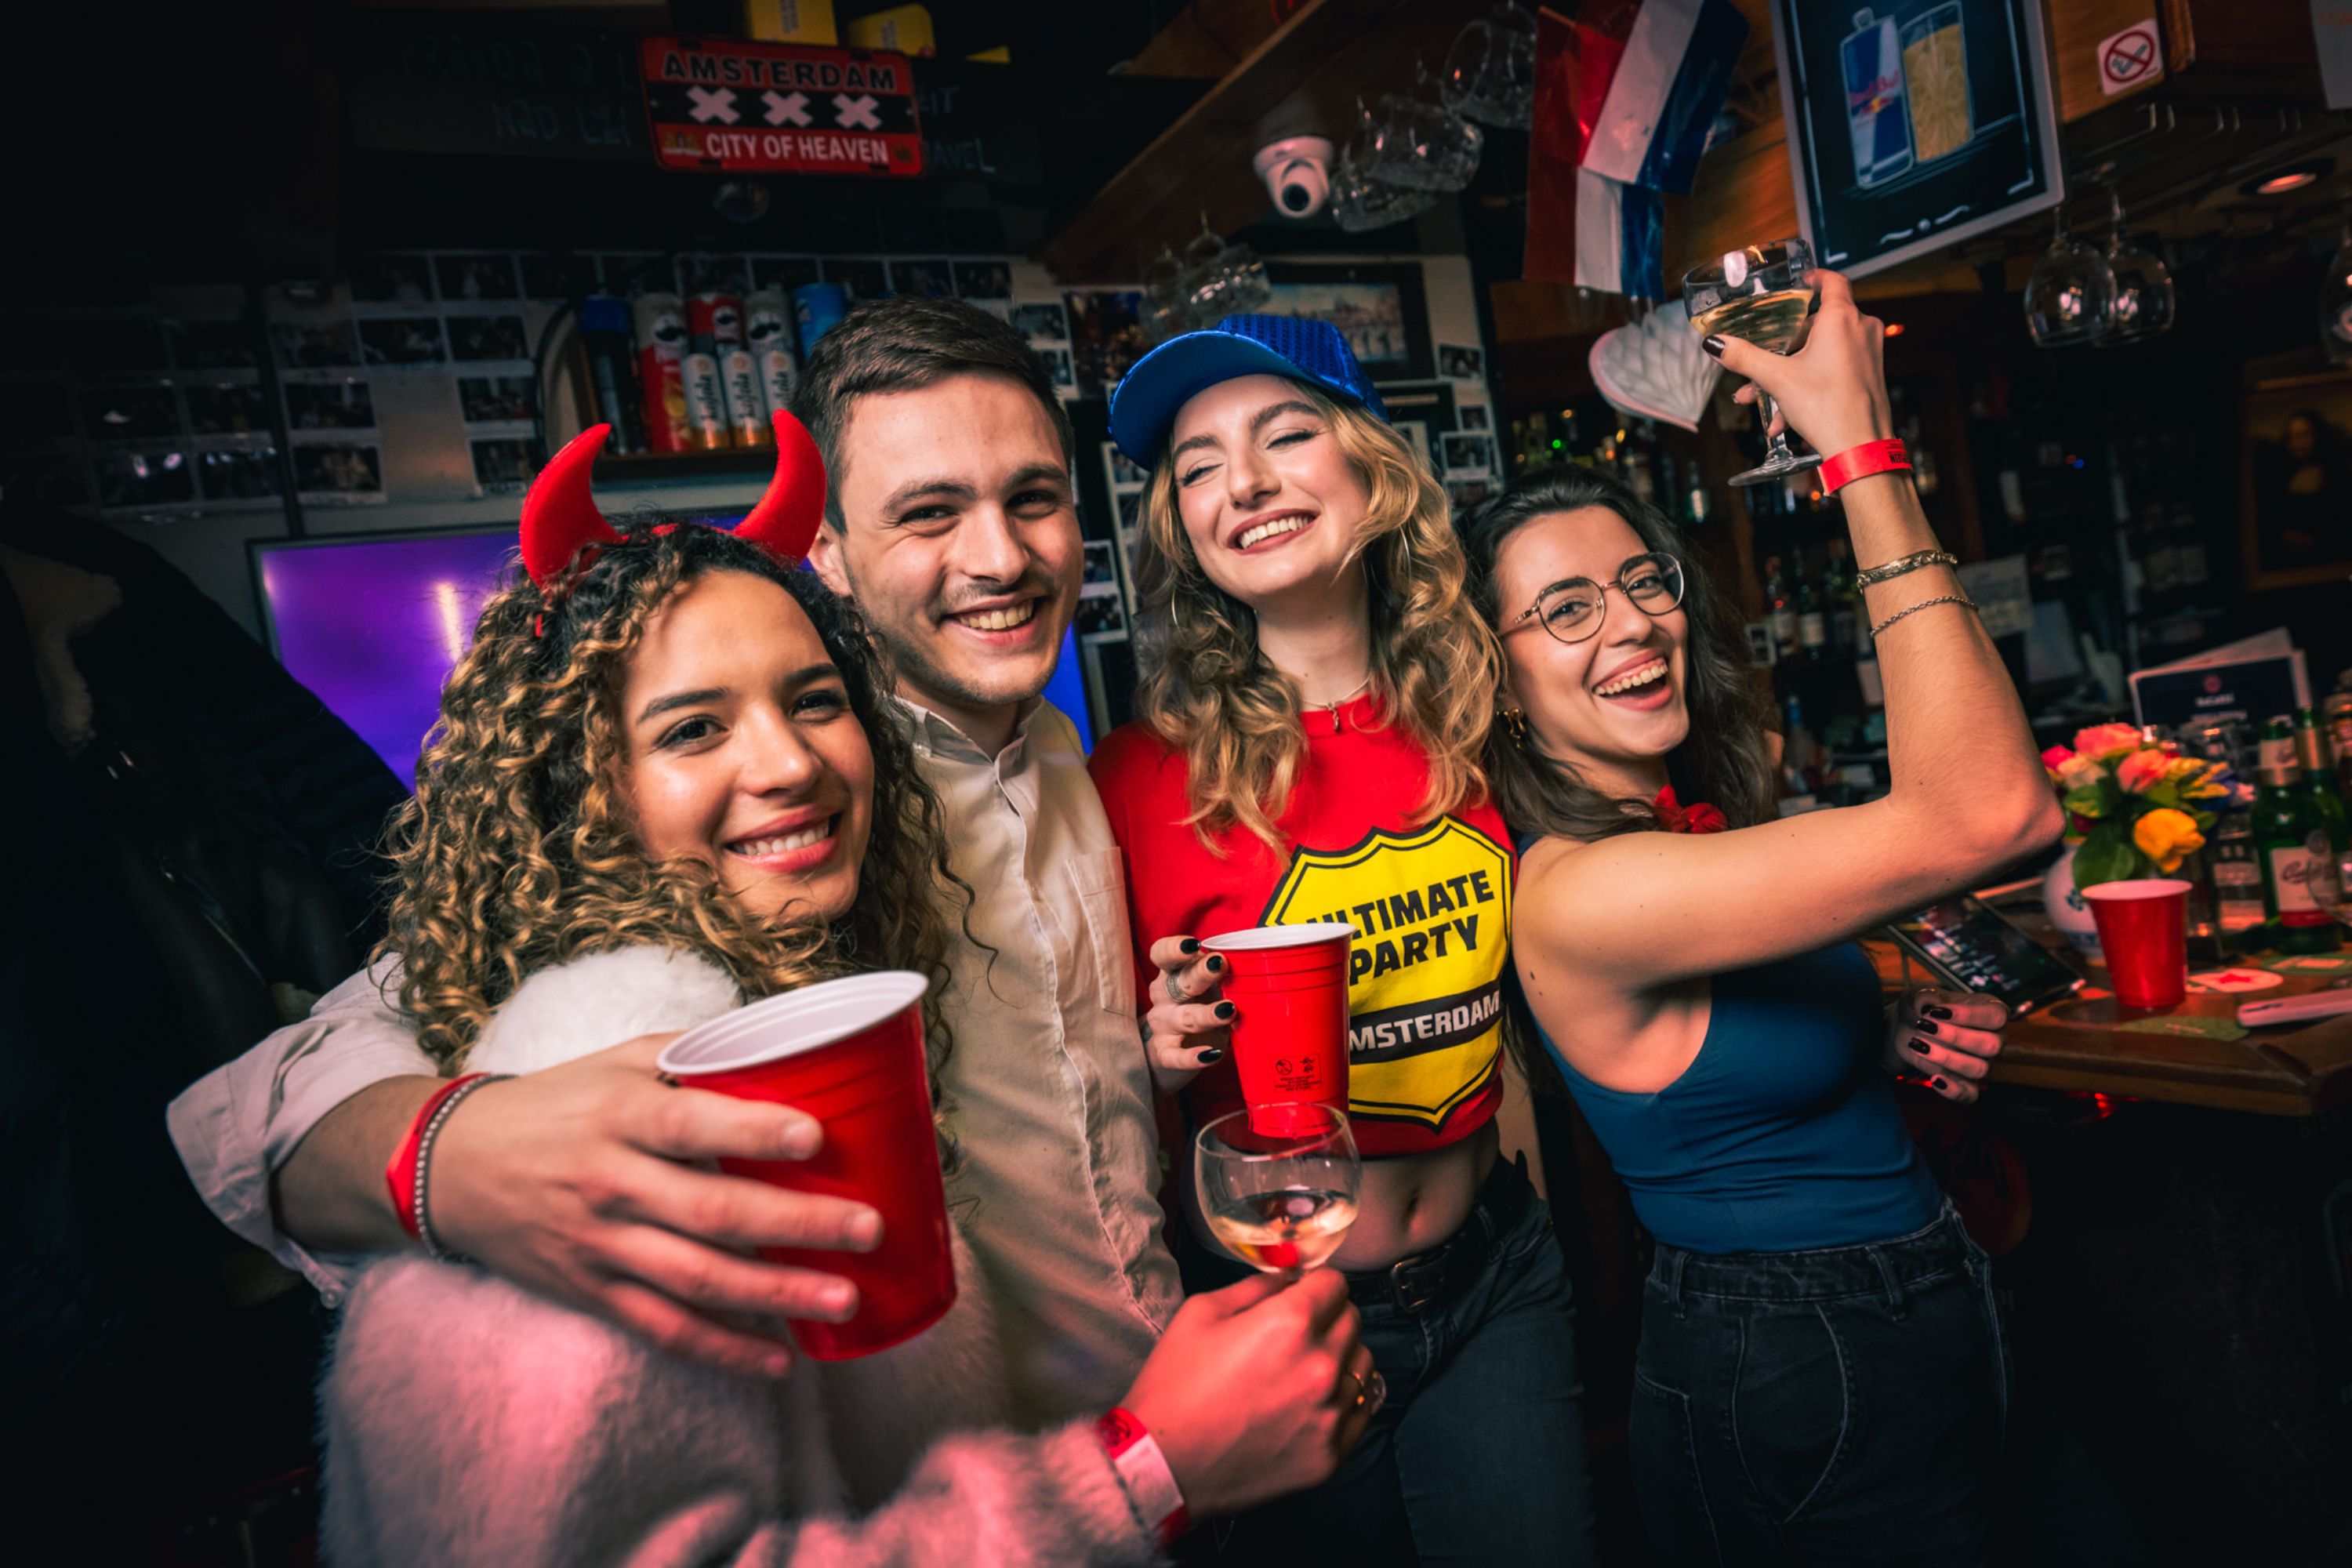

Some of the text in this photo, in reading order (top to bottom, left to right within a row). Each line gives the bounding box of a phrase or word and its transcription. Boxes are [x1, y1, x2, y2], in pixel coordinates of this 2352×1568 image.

[663, 51, 897, 93] AMSTERDAM
[706, 132, 889, 163] CITY OF HEAVEN
[1307, 869, 1494, 940] LTIMATE
[1349, 914, 1479, 986] PARTY
[1350, 989, 1500, 1051] MSTERDAM
